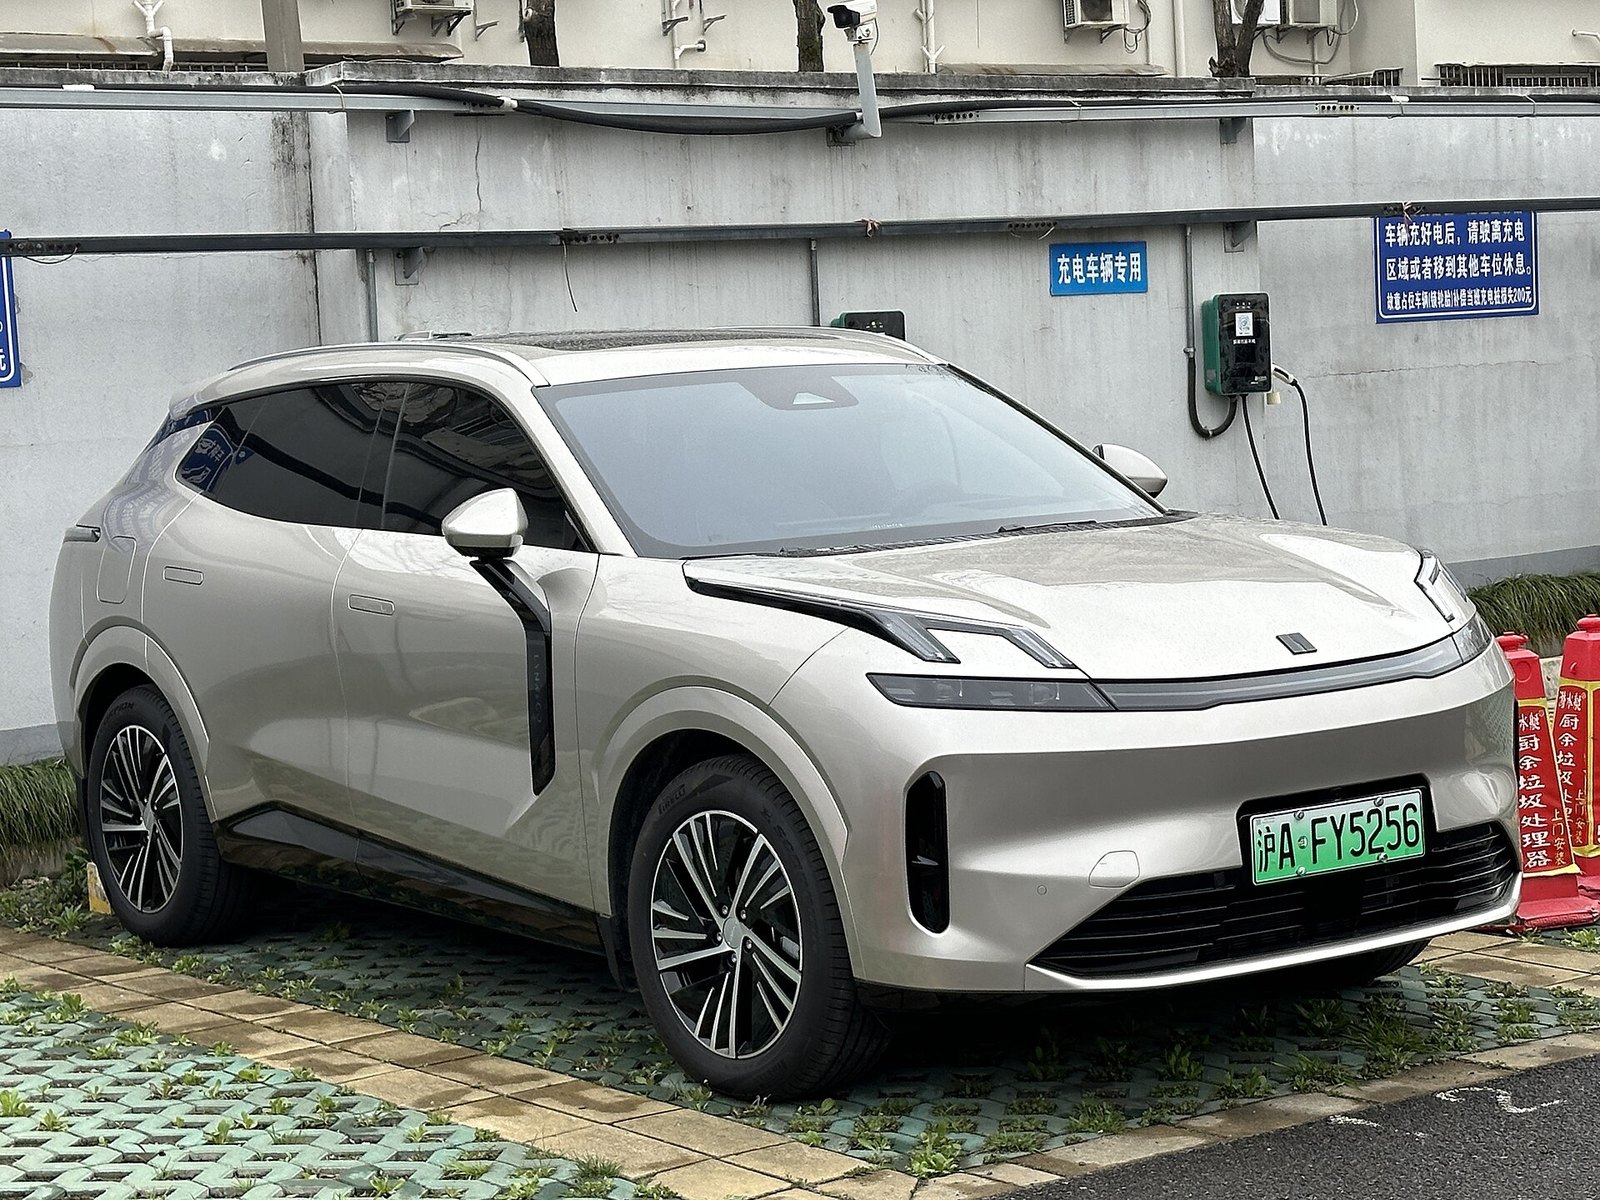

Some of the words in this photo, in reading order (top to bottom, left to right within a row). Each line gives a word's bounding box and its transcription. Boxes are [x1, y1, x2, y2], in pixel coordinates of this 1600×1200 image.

[1057, 252, 1142, 284] 充电车辆专用
[1386, 252, 1532, 281] 区域或者移到其他车位休息。
[1518, 733, 1551, 868] 厨余垃圾处理器
